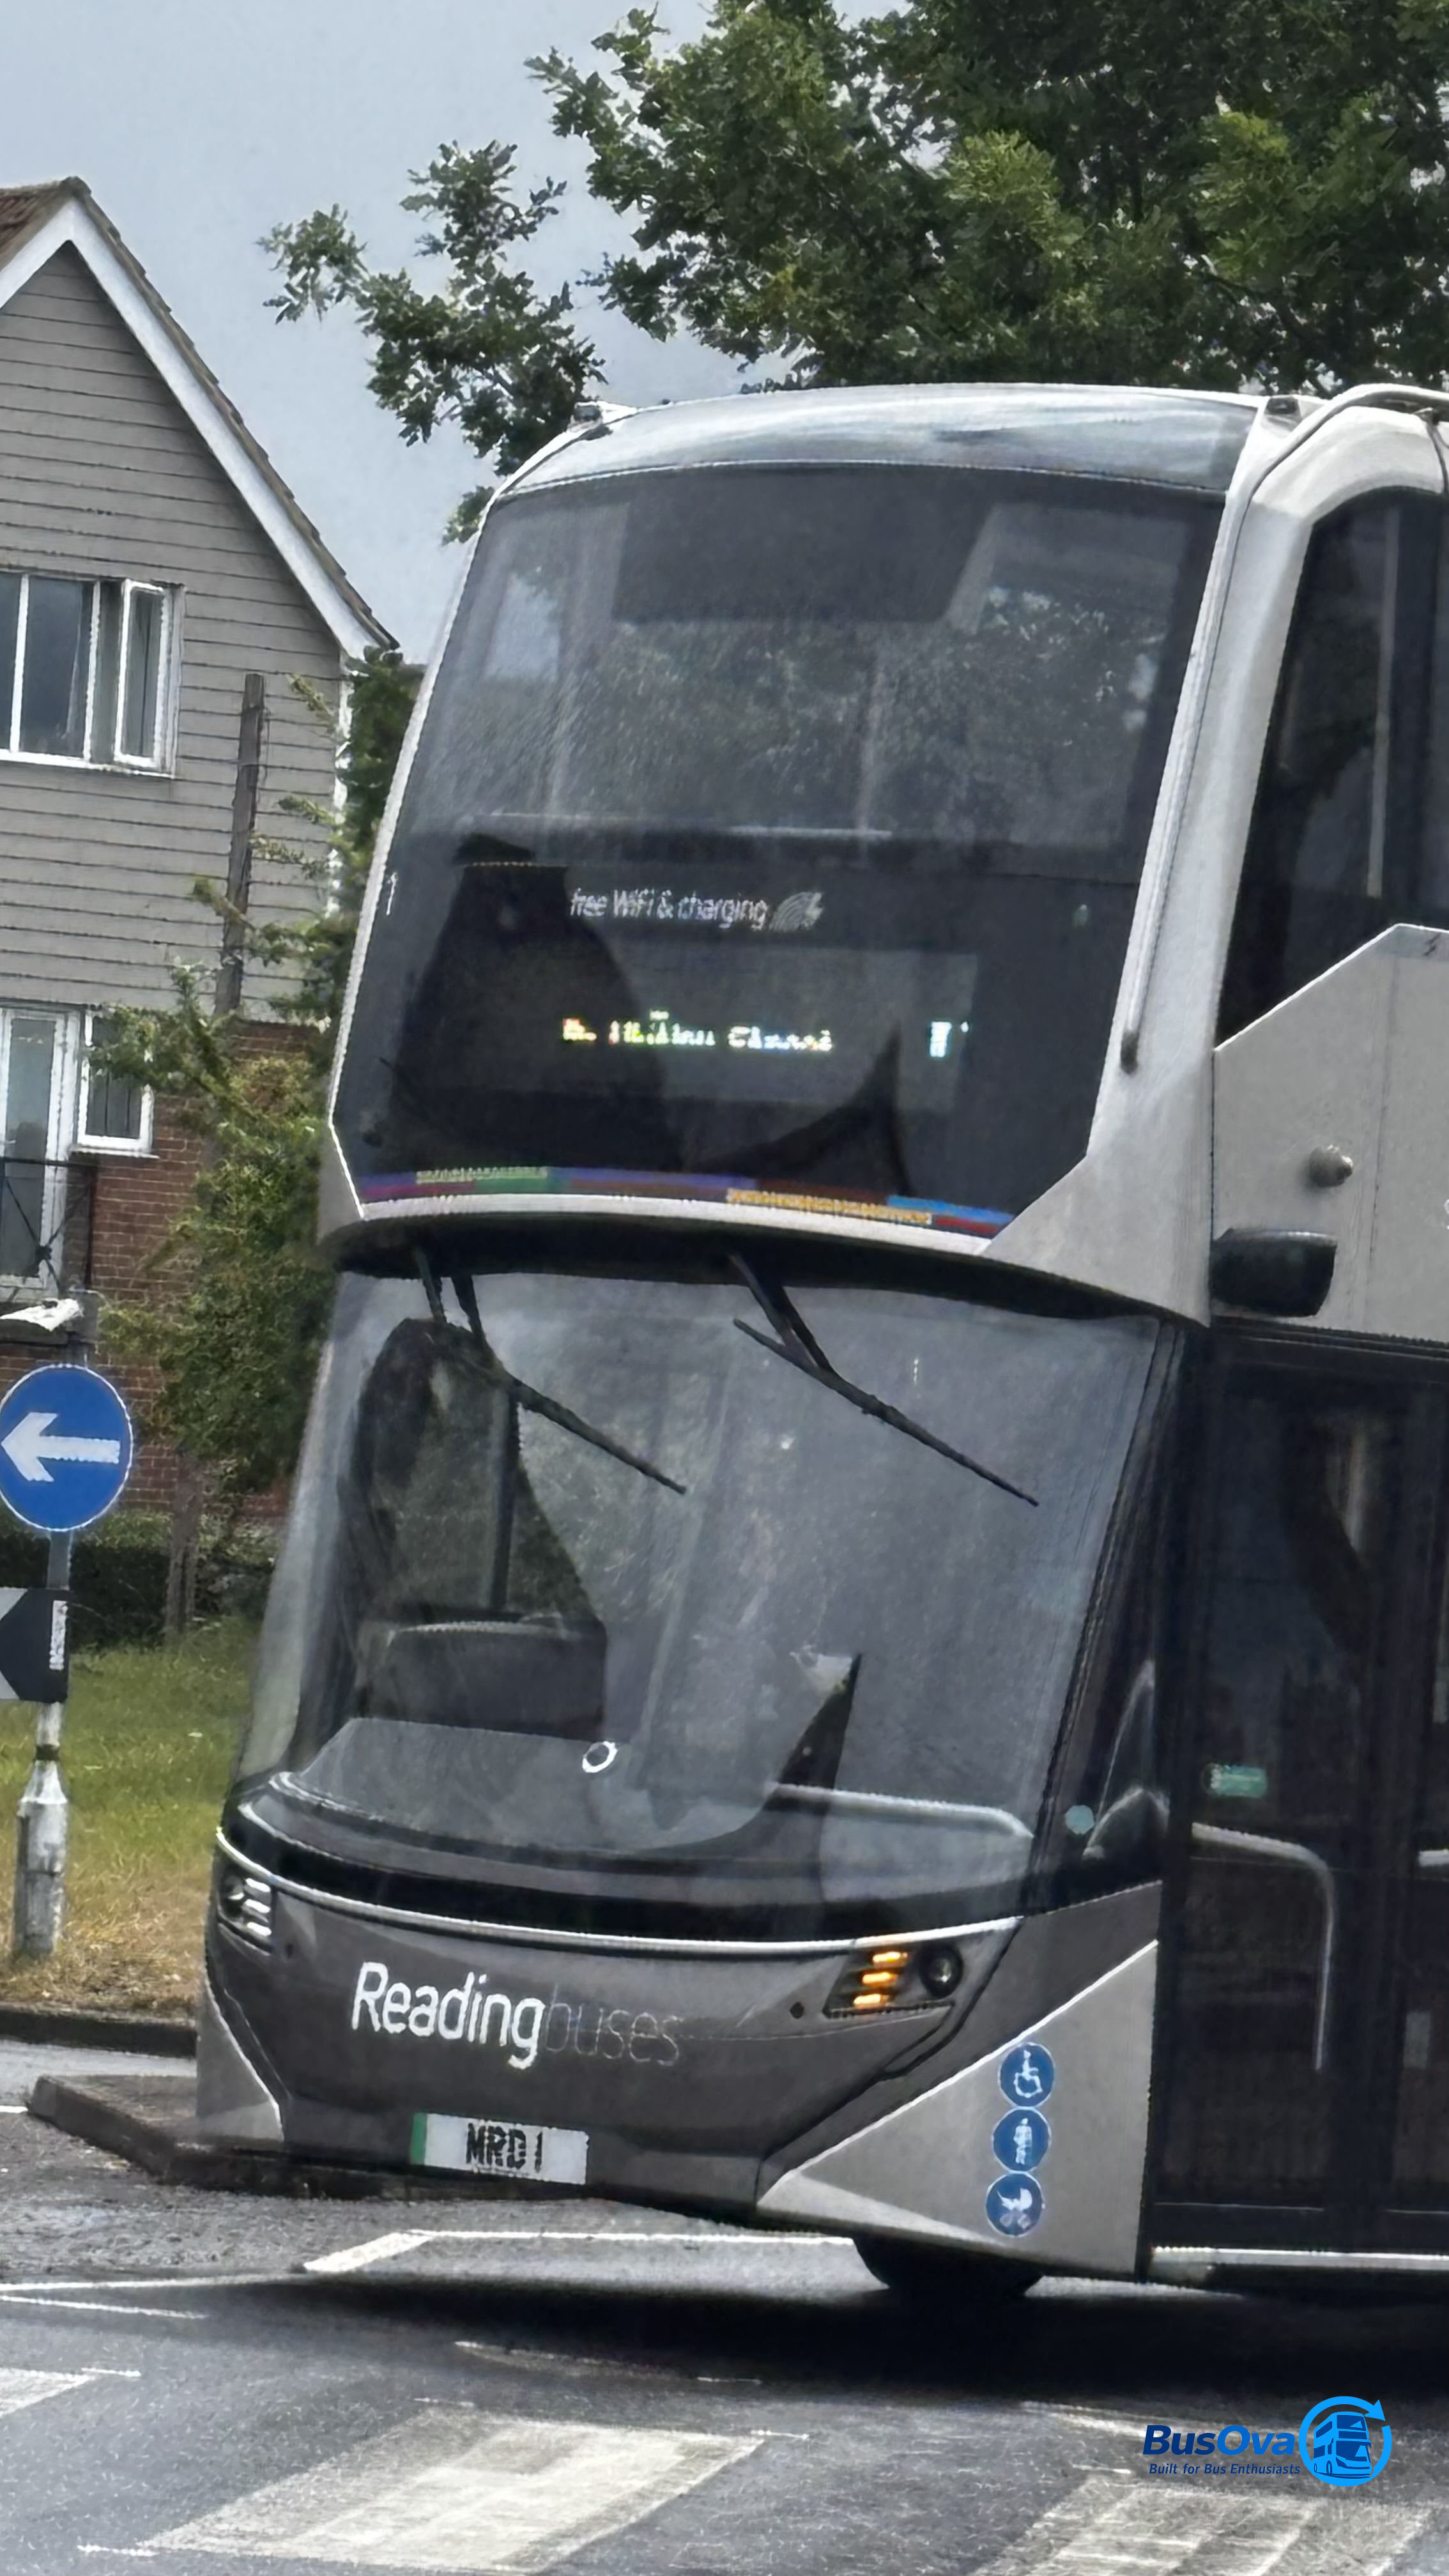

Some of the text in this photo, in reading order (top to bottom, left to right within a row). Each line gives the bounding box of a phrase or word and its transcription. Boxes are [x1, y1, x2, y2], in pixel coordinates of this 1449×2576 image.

[570, 887, 608, 916] free
[657, 889, 674, 919] &
[677, 891, 769, 931] charging
